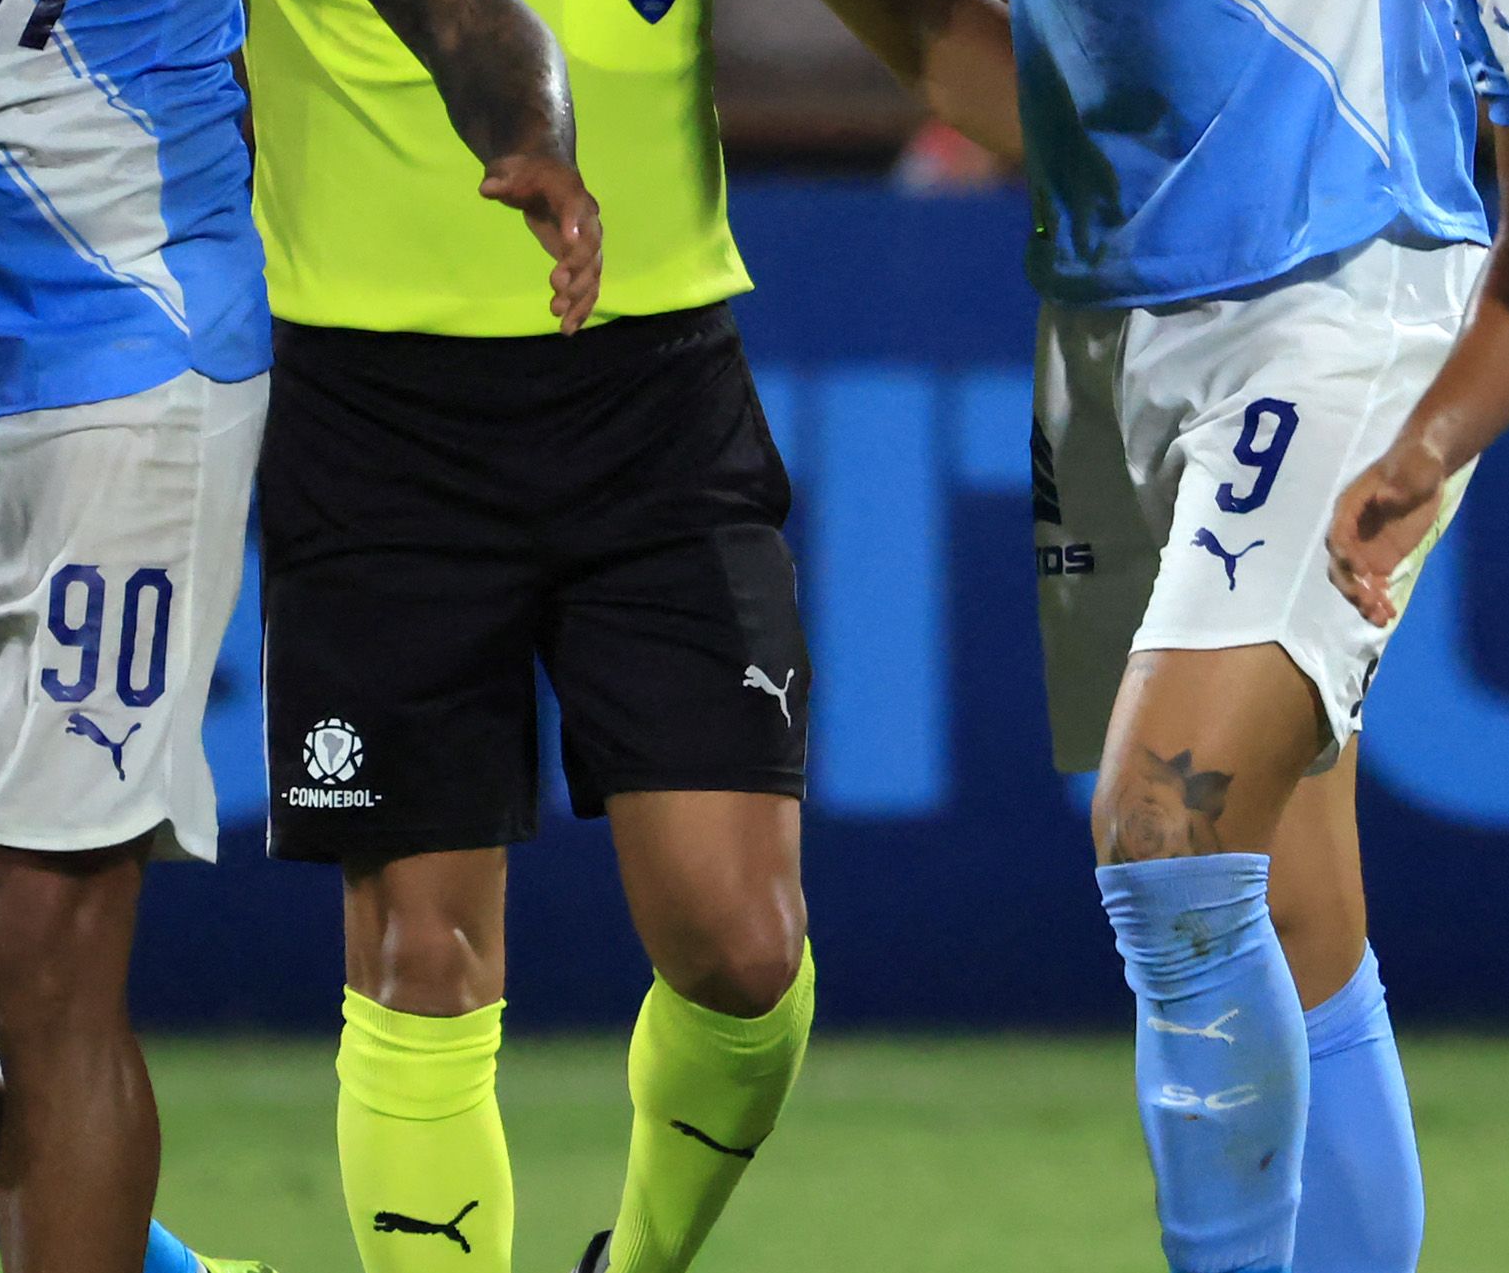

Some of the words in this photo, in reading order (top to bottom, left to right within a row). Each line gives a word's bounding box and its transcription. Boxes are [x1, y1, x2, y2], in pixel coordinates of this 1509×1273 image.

[1215, 398, 1299, 513] 9
[41, 564, 174, 708] 90
[1159, 1084, 1260, 1109] SC
